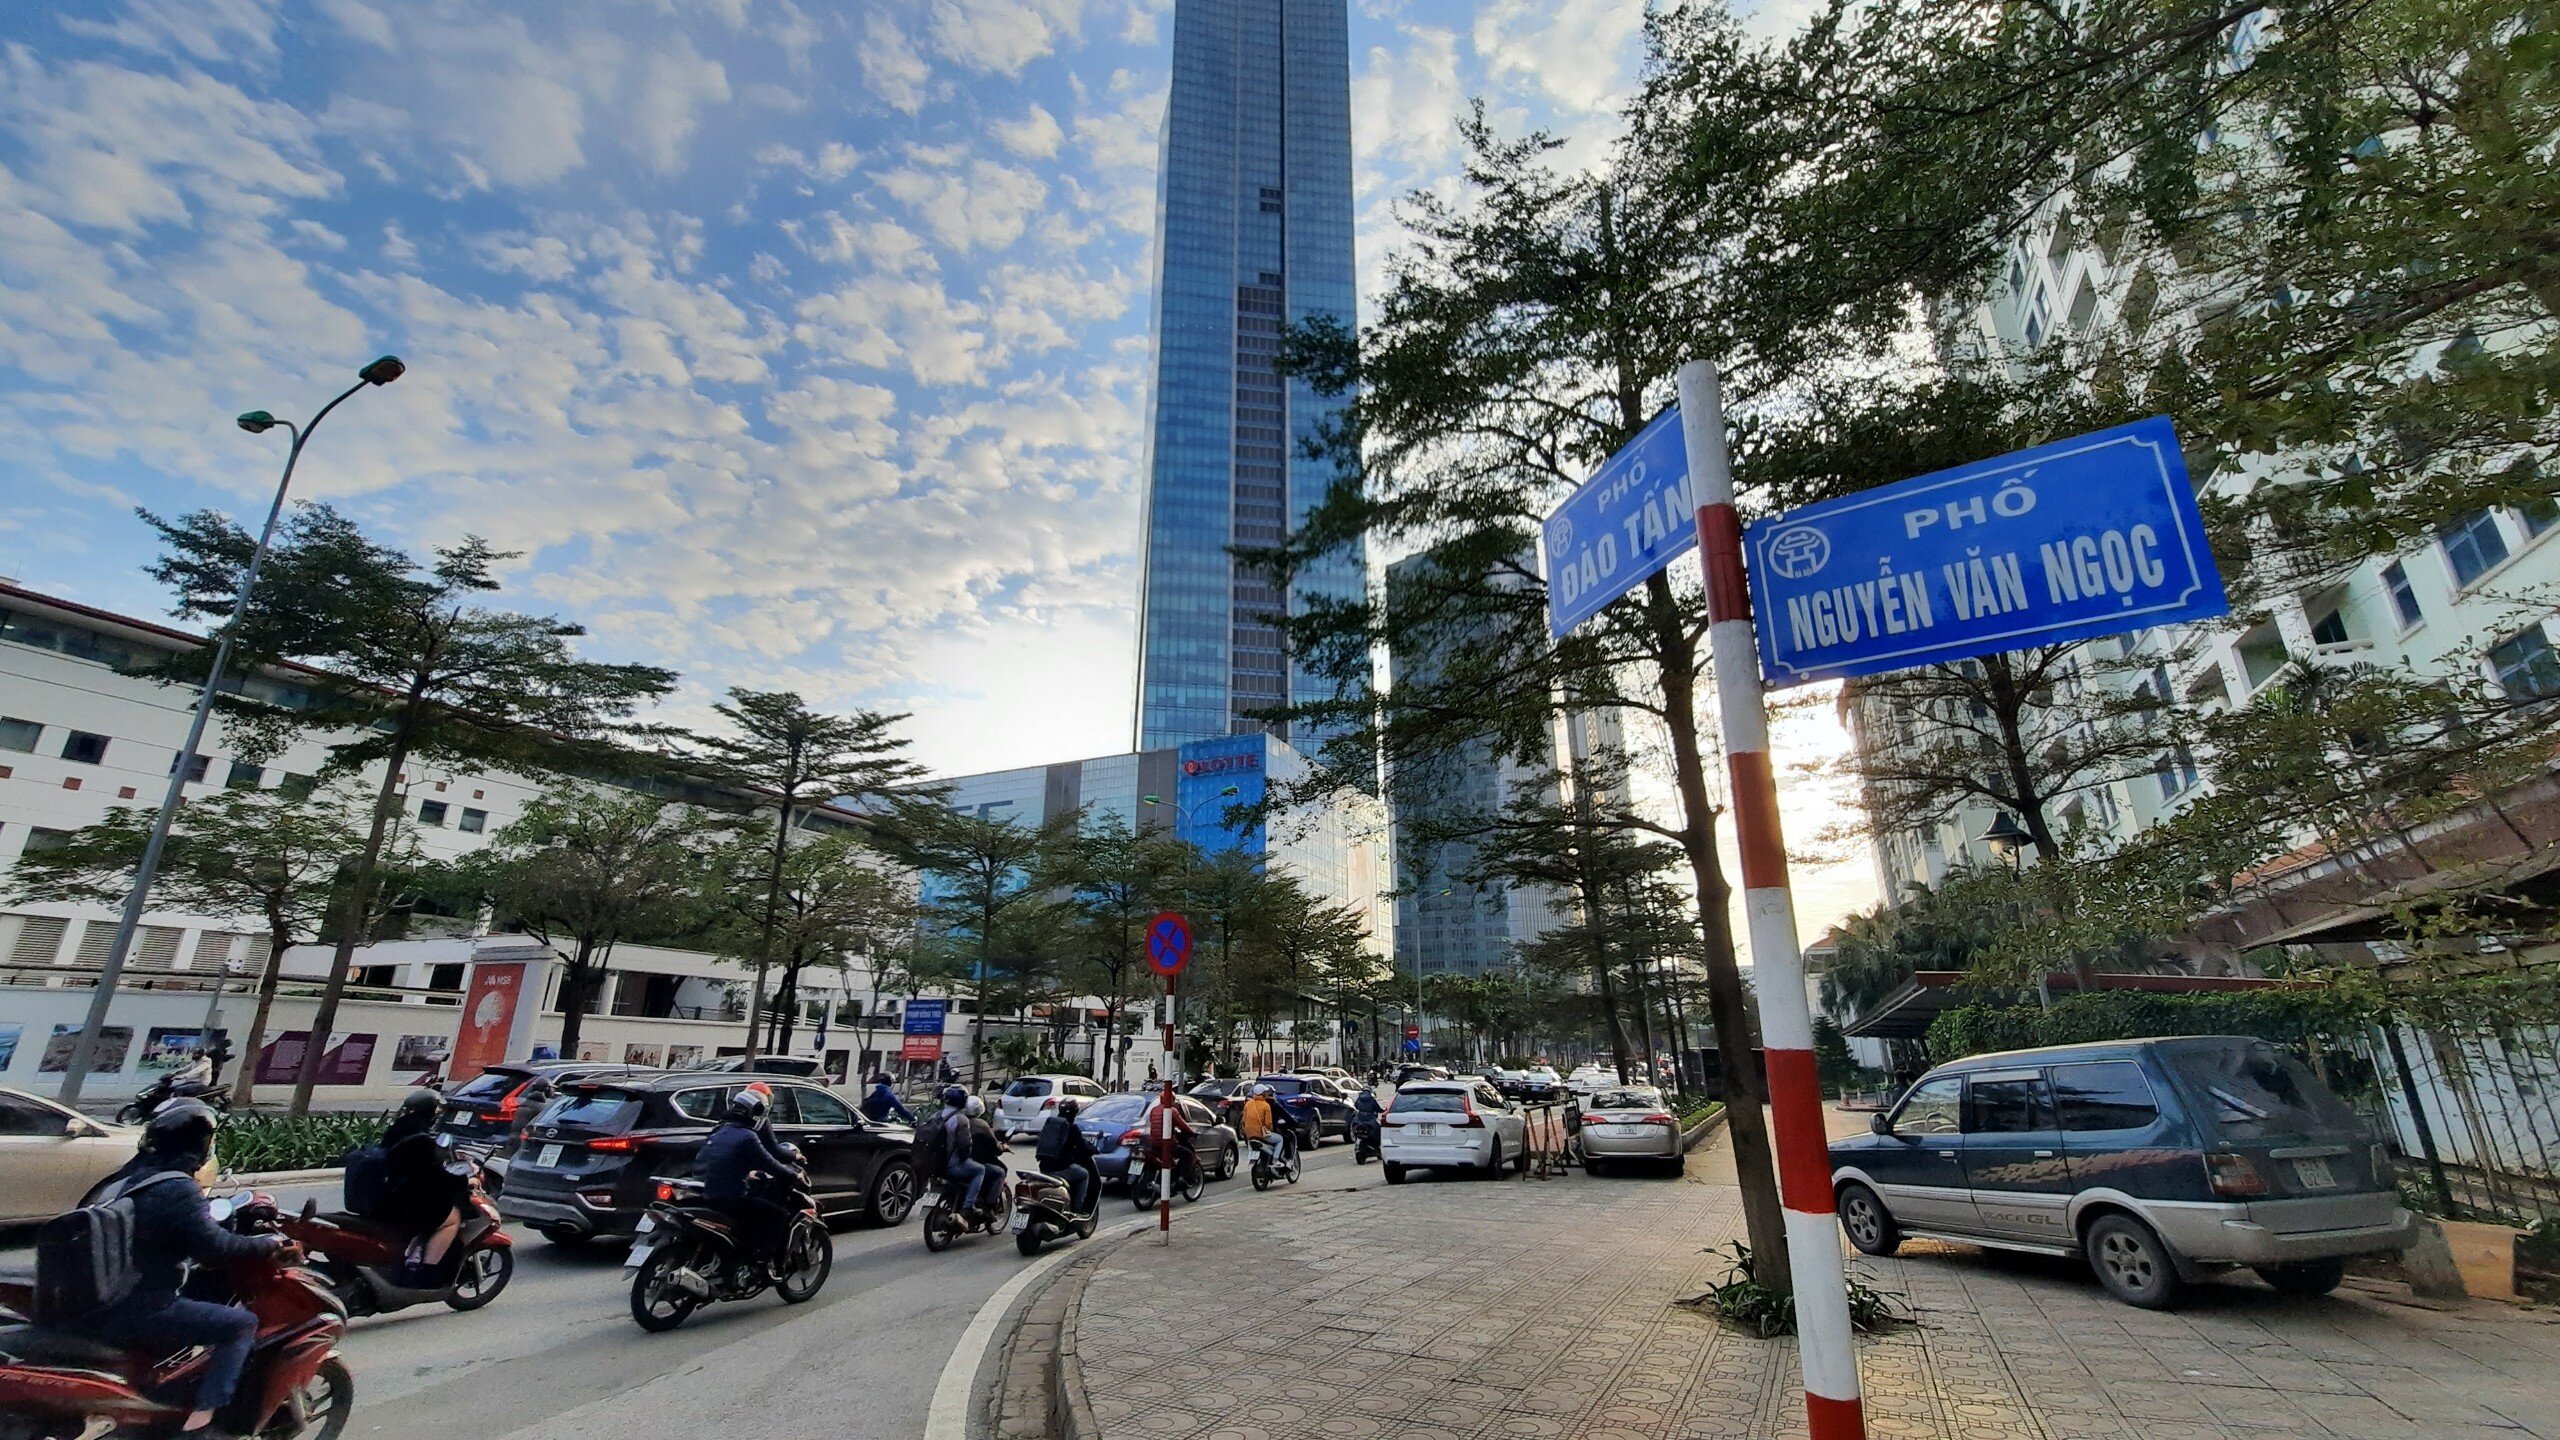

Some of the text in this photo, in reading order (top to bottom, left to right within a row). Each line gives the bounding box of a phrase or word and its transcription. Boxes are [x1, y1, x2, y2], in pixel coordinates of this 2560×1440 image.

[1597, 446, 1646, 514] PHỐ
[1903, 468, 2040, 540] PHỐ
[1560, 473, 1695, 607] ĐÀO TẤN
[1787, 523, 2166, 653] NGUYỄN VĂN NGỌC
[1198, 752, 1259, 771] LOTTE
[2027, 1214, 2063, 1227] GL
